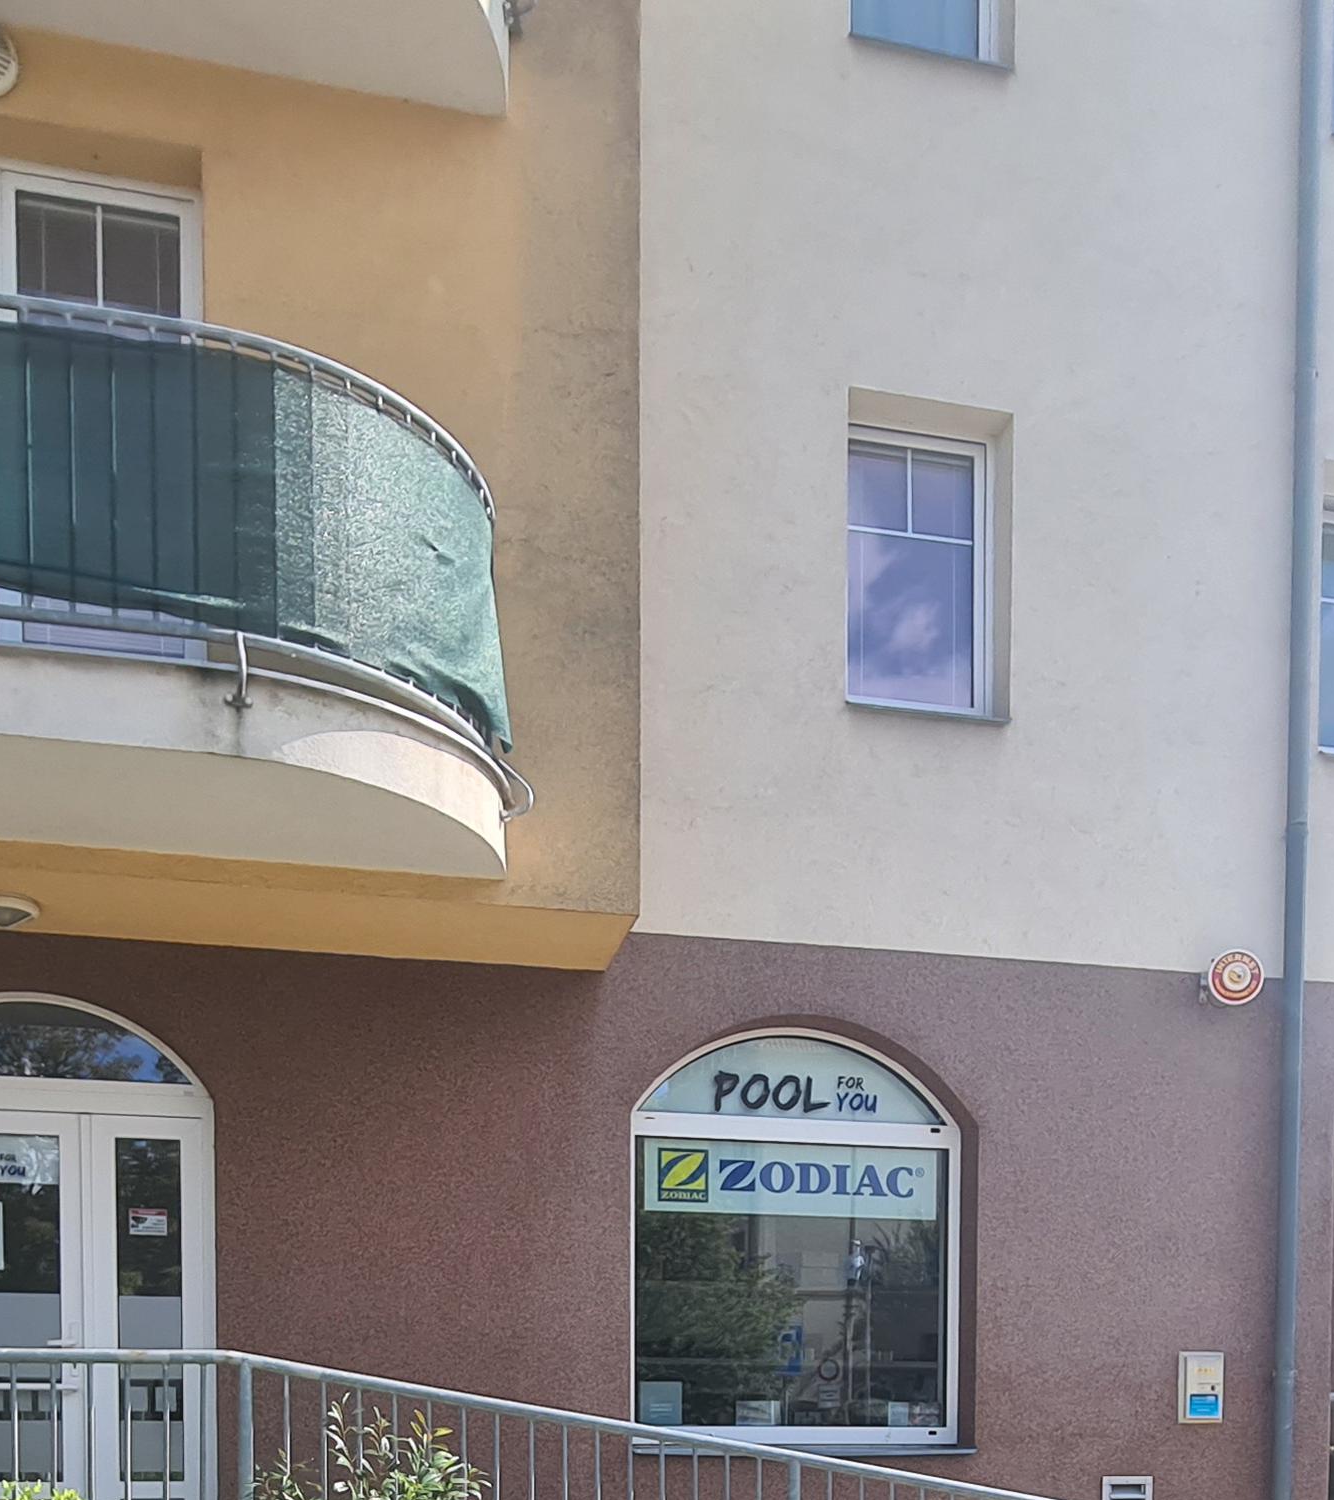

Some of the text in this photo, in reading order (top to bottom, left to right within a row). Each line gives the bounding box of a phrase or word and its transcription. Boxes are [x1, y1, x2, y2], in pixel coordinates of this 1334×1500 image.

[837, 1076, 864, 1091] FOR
[714, 1070, 831, 1113] POOL
[836, 1092, 878, 1113] YOU
[0, 1153, 17, 1162] FOR
[0, 1165, 26, 1177] YOU
[719, 1159, 914, 1198] ZODIAC
[660, 1190, 707, 1200] ZODIAC
